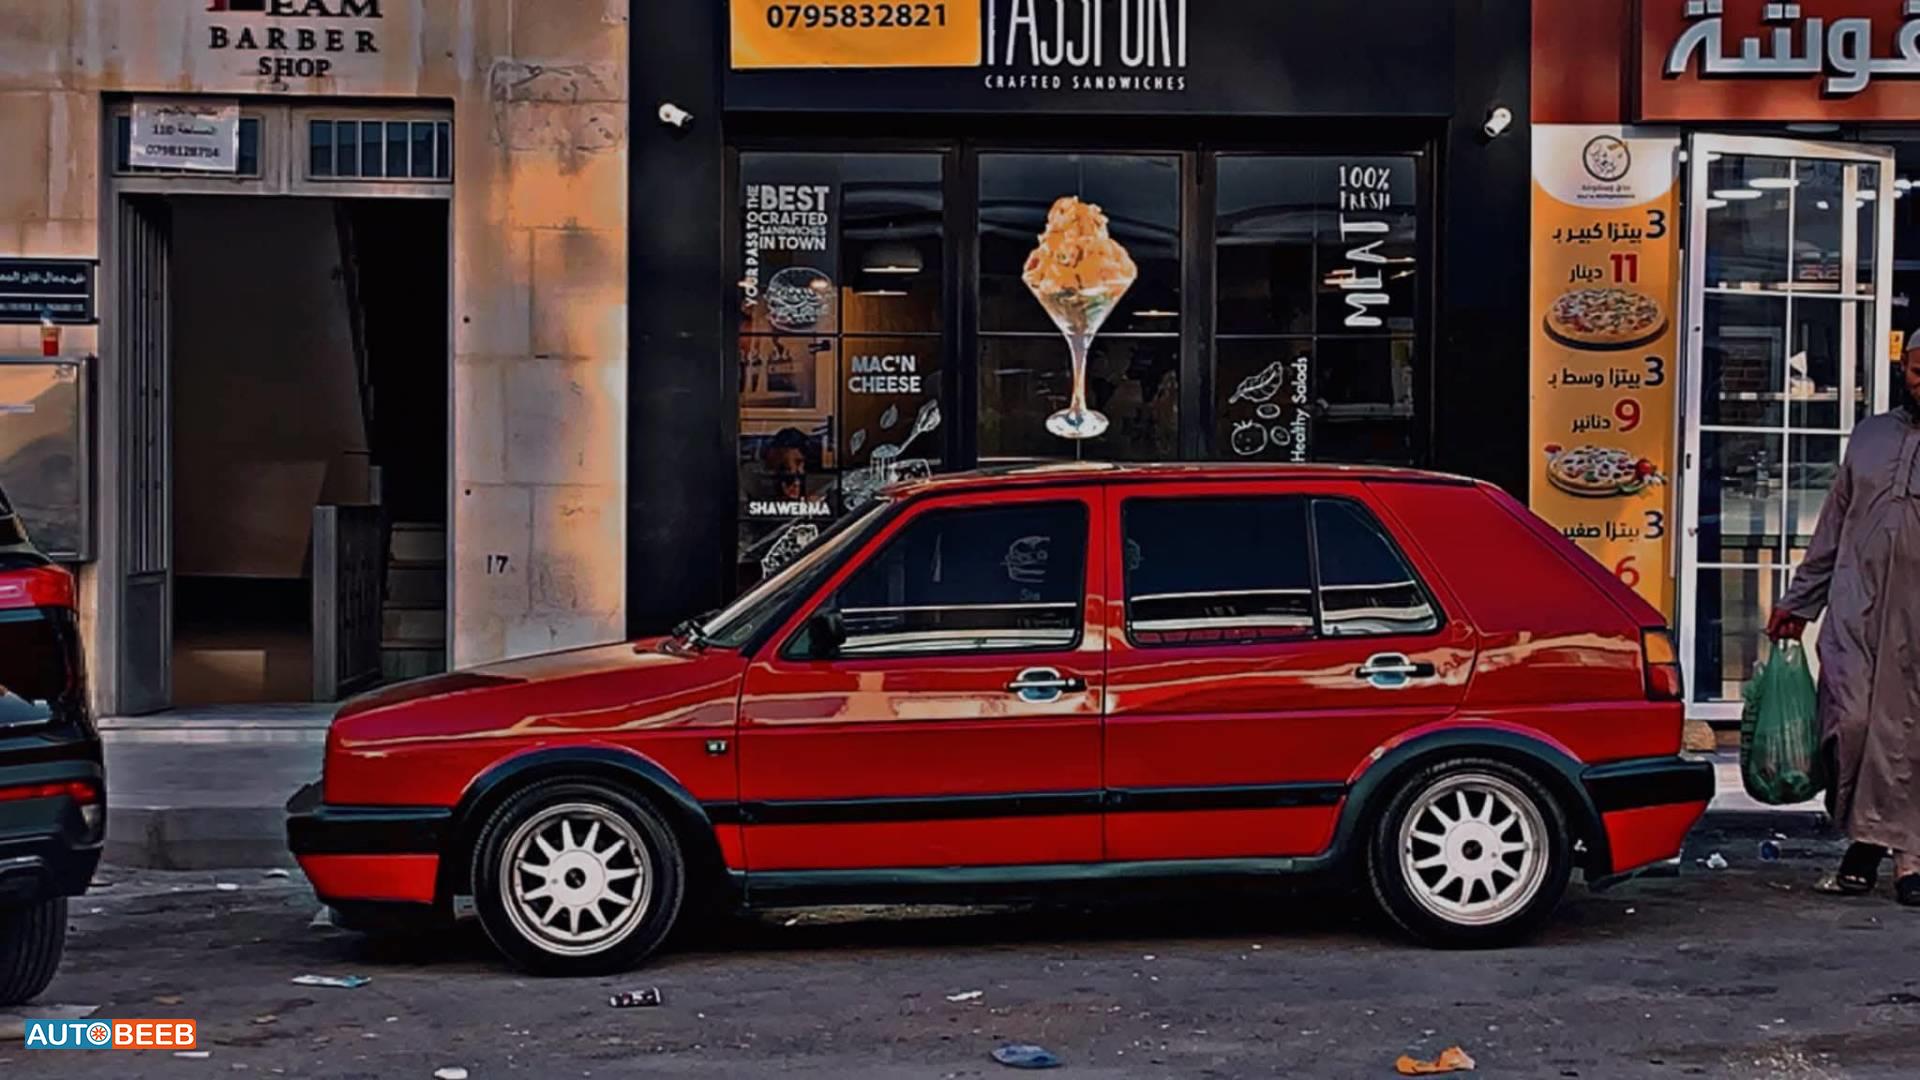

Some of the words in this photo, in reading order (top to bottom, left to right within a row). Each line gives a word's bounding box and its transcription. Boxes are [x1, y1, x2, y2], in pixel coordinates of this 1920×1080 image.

[206, 0, 383, 17] EAM
[766, 4, 946, 28] 0795832821
[209, 26, 378, 53] BARBER
[259, 56, 332, 78] SHOP
[985, 75, 1061, 89] CRAFTED
[1072, 76, 1185, 90] SANDWICHES
[1340, 165, 1390, 190] 100%
[746, 184, 759, 209] THE
[761, 185, 830, 211] BEST
[1340, 190, 1390, 210] FRESH
[746, 211, 759, 229] TO
[759, 211, 828, 225] CRAFTED
[1646, 209, 1667, 240] 3
[760, 225, 826, 236] SANDWICHES
[1566, 222, 1603, 244] كبير
[1608, 222, 1642, 244] بيتزا
[745, 231, 759, 265] PASS
[760, 236, 776, 250] IN
[778, 236, 826, 250] TOWN
[1340, 213, 1390, 326] MEAT
[1569, 264, 1603, 284] دينار
[1610, 253, 1638, 284] 11
[745, 267, 759, 306] YOUR
[851, 355, 916, 373] MAC'N
[1644, 356, 1665, 387] 3
[848, 375, 921, 393] CHEESE
[1290, 356, 1308, 404] Salads
[1562, 368, 1604, 388] وسط
[1609, 368, 1641, 389] بيتزا
[1572, 413, 1611, 434] دنانير
[1615, 399, 1641, 432] 9
[1290, 408, 1310, 462] Healthy
[749, 501, 830, 516] SHAWERMA
[1606, 521, 1640, 542] بيتزا
[1644, 510, 1665, 539] 3
[487, 554, 508, 574] 17
[1616, 555, 1640, 588] 6
